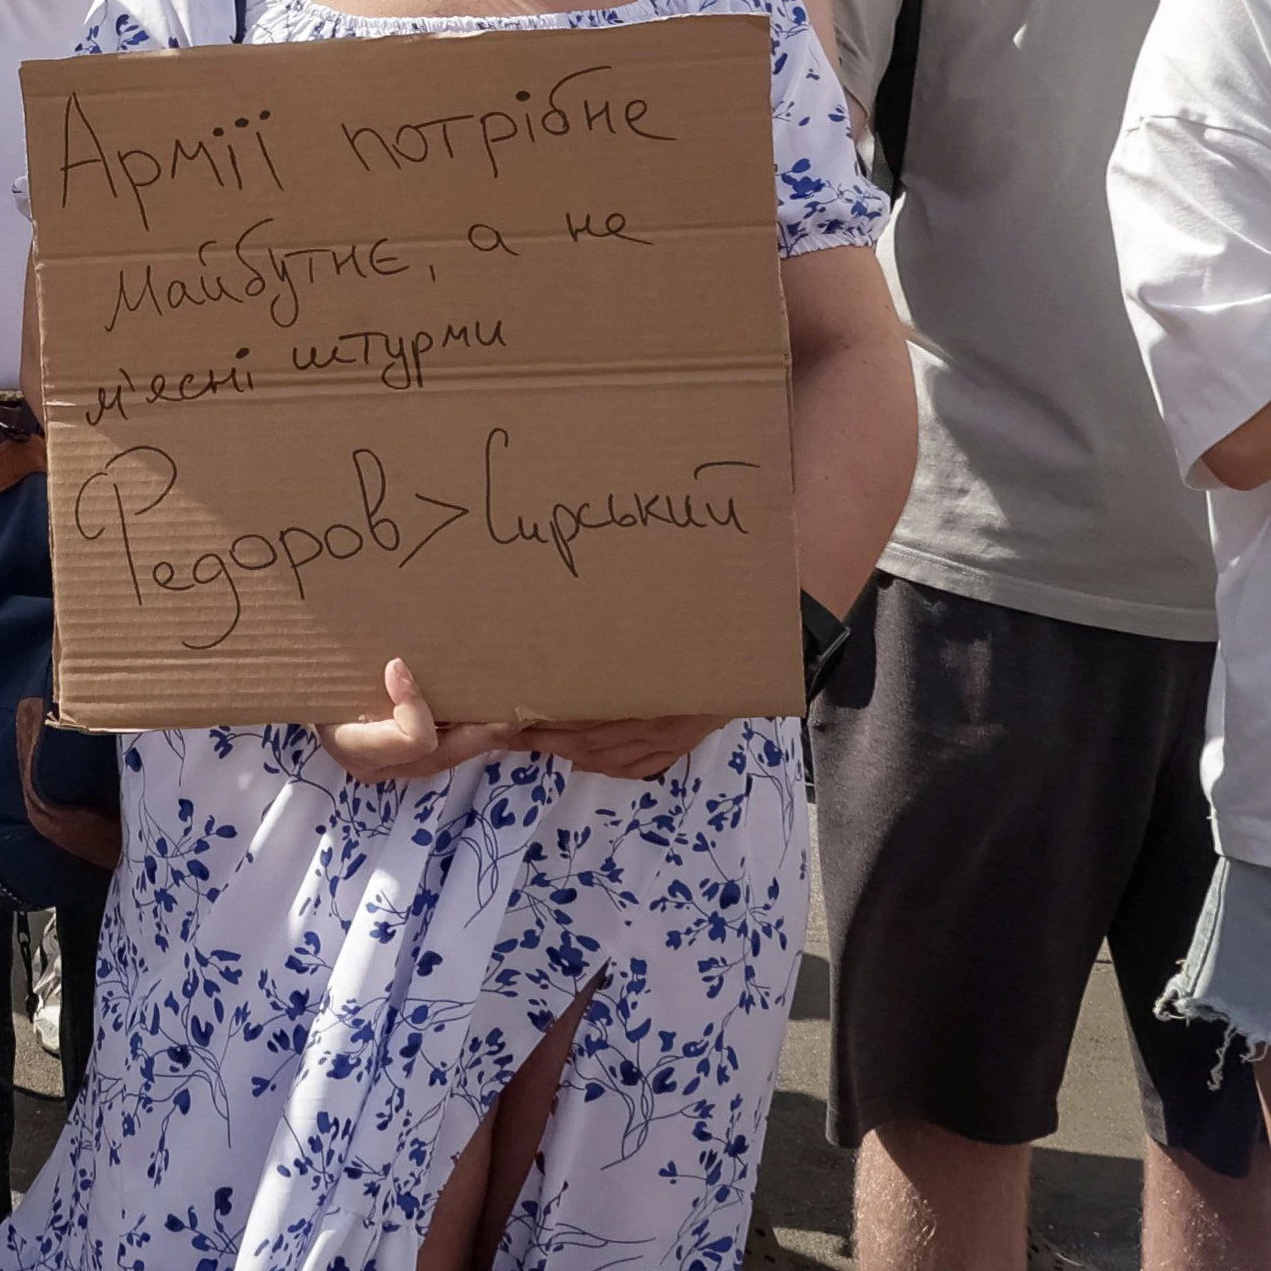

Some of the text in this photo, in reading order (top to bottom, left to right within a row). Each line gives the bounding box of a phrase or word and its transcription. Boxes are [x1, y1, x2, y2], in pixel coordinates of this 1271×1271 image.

[59, 66, 677, 232] Армії потрібне
[564, 210, 654, 246] не
[292, 320, 507, 390] штурми
